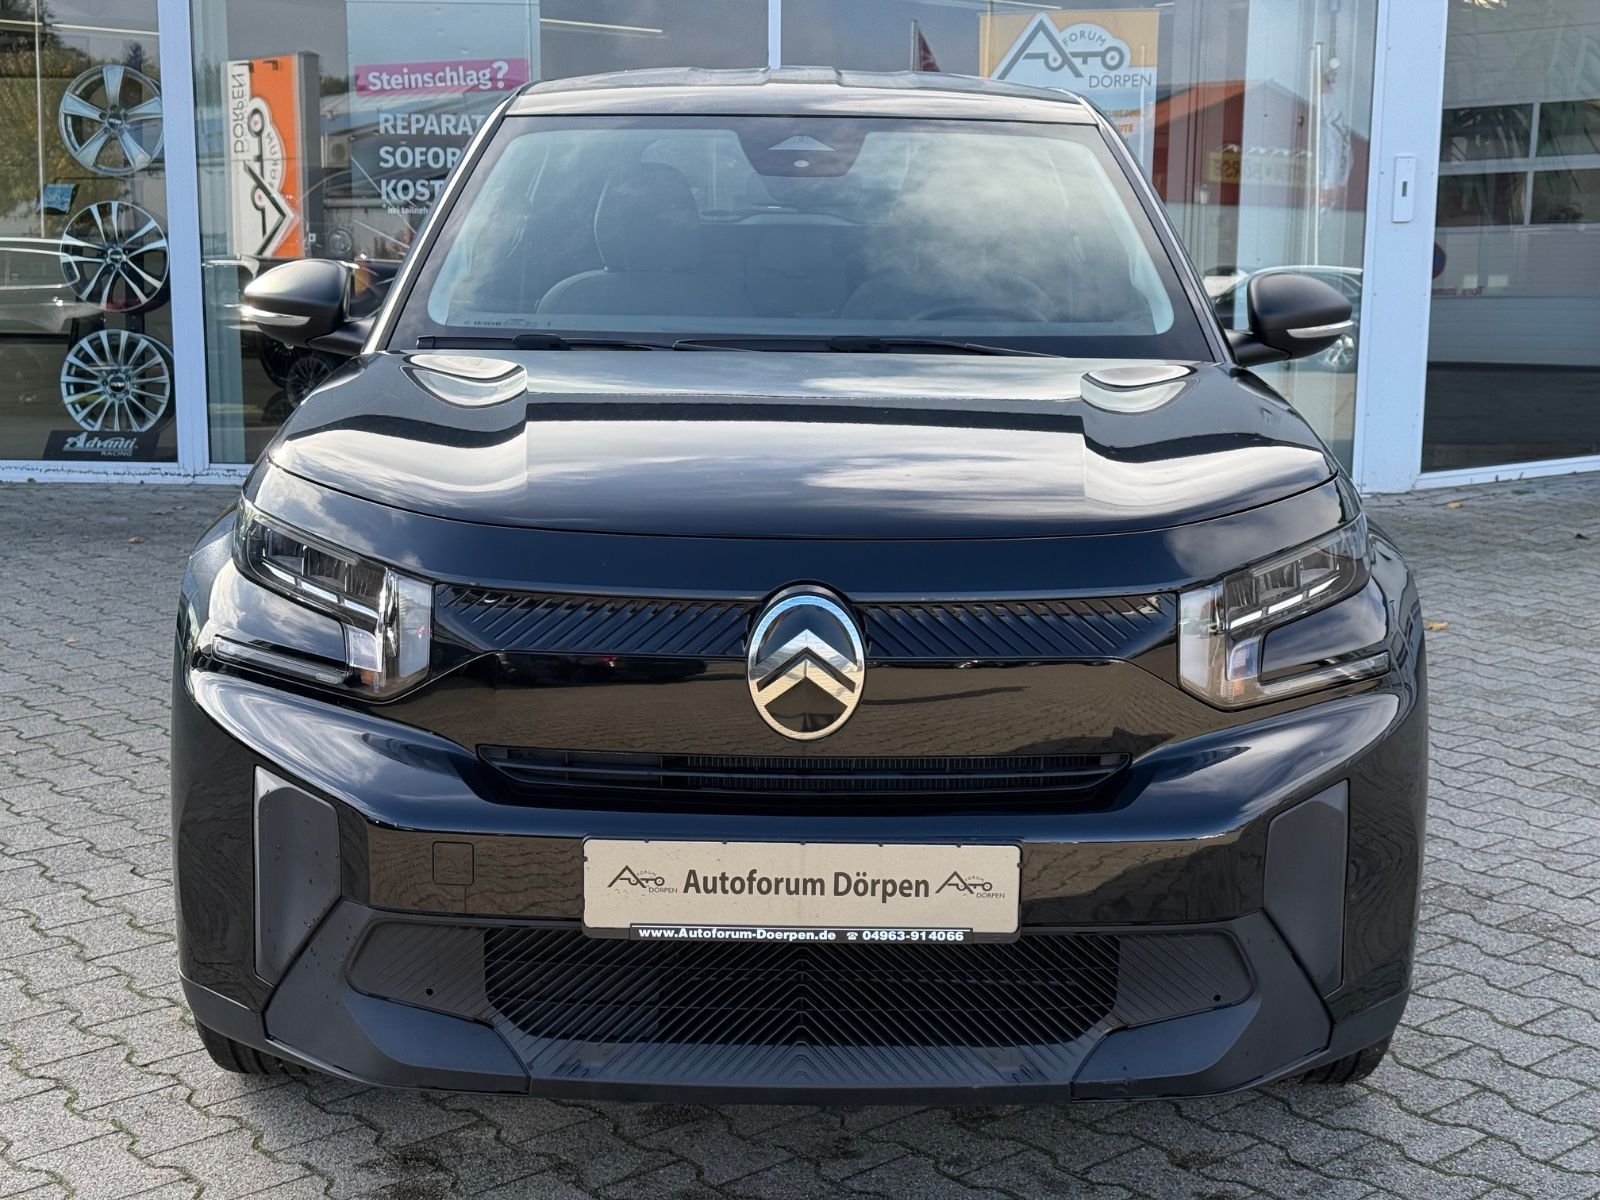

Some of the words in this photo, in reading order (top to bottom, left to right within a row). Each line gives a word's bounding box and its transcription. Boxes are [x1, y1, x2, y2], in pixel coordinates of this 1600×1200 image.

[1062, 30, 1106, 47] FORUM
[368, 61, 509, 91] Steinschlag?
[378, 146, 466, 169] SOFOR
[62, 432, 139, 452] Advanti
[683, 868, 826, 896] Autoforum
[833, 871, 930, 903] Dörpen
[638, 927, 837, 942] www.Autoforum-Doerpen.de
[862, 930, 965, 942] 04963-914066
